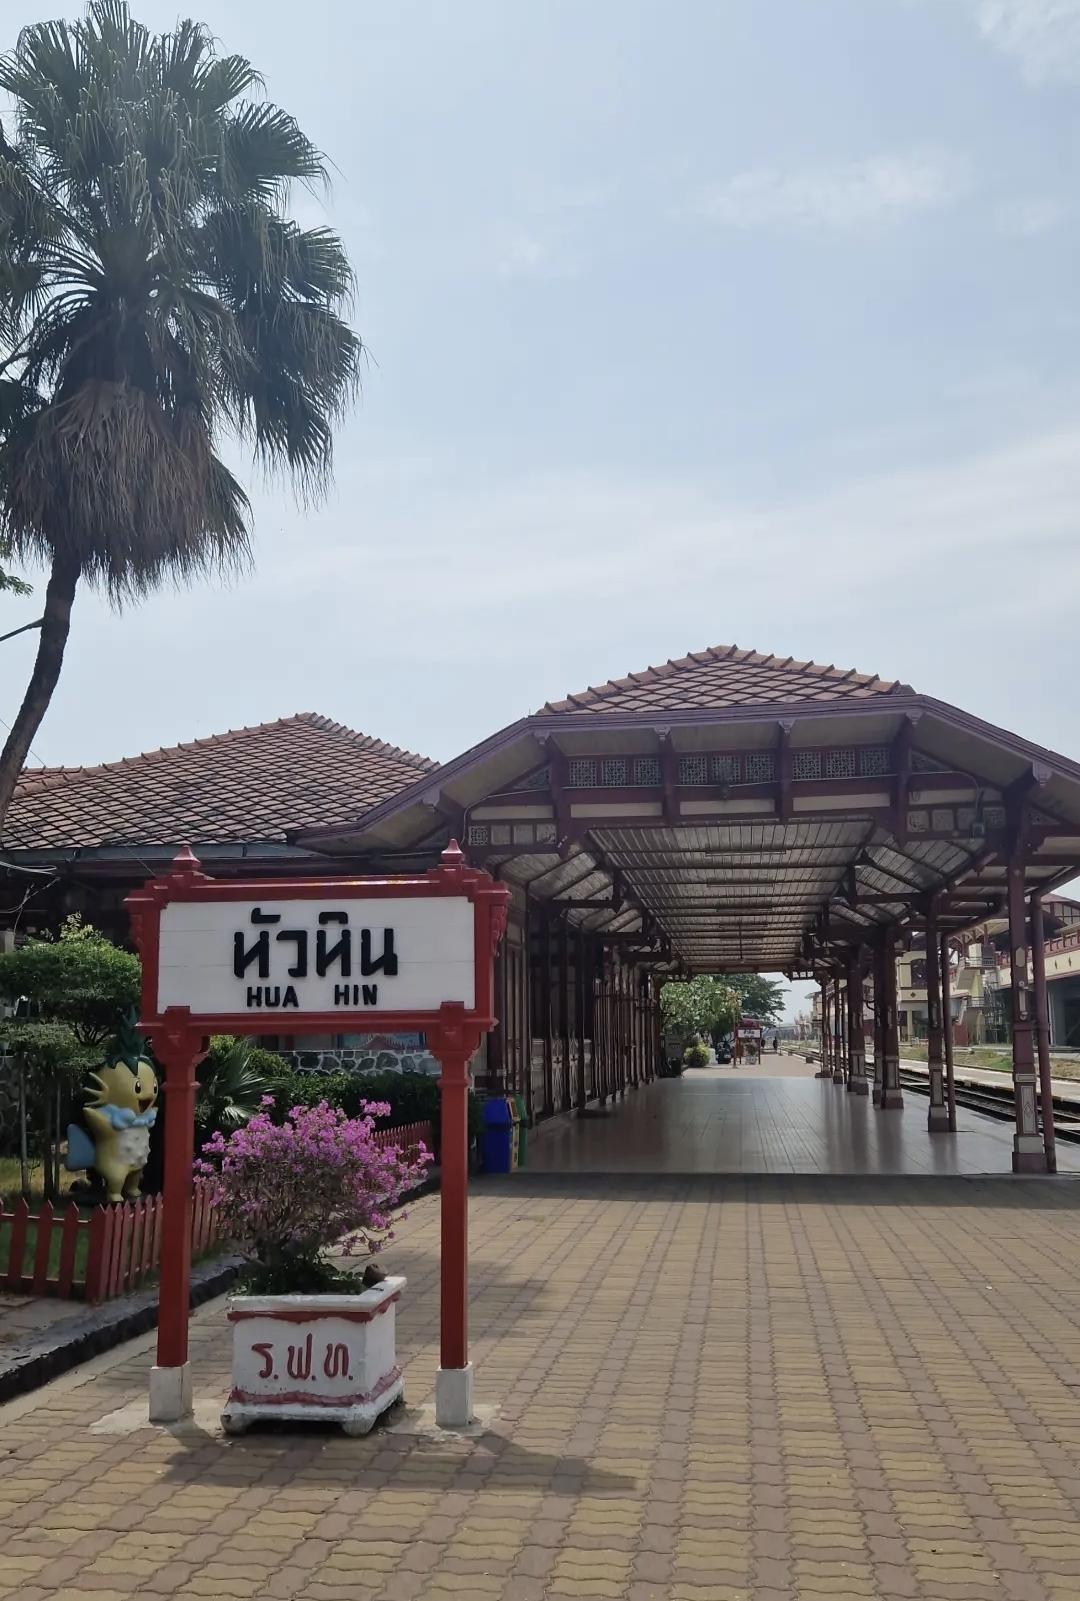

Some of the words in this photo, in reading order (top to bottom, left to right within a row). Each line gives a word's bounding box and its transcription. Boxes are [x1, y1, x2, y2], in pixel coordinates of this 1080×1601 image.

[234, 907, 398, 978] หัวหิน
[246, 985, 300, 1007] HUA
[334, 984, 378, 1005] HIN
